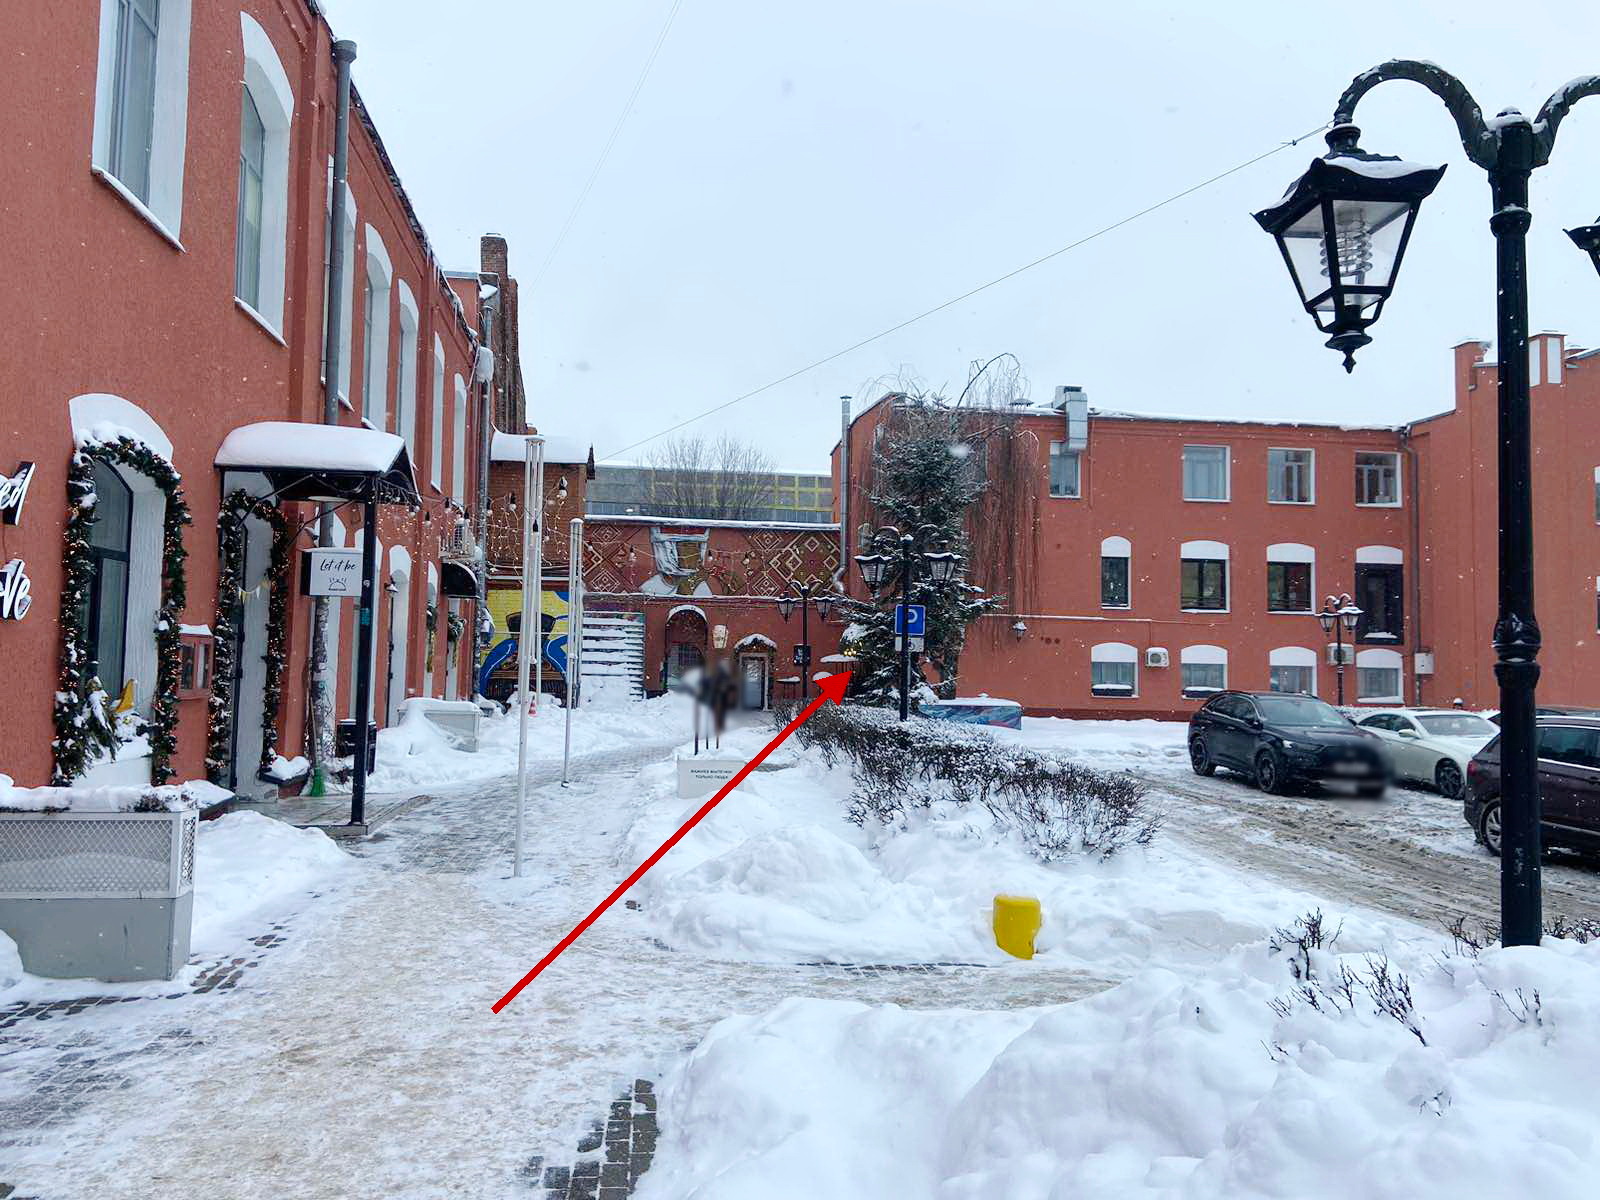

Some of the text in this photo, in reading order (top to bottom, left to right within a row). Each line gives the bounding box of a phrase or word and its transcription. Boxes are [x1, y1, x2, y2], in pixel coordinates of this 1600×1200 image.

[320, 559, 357, 572] Let it be
[0, 559, 32, 621] ve
